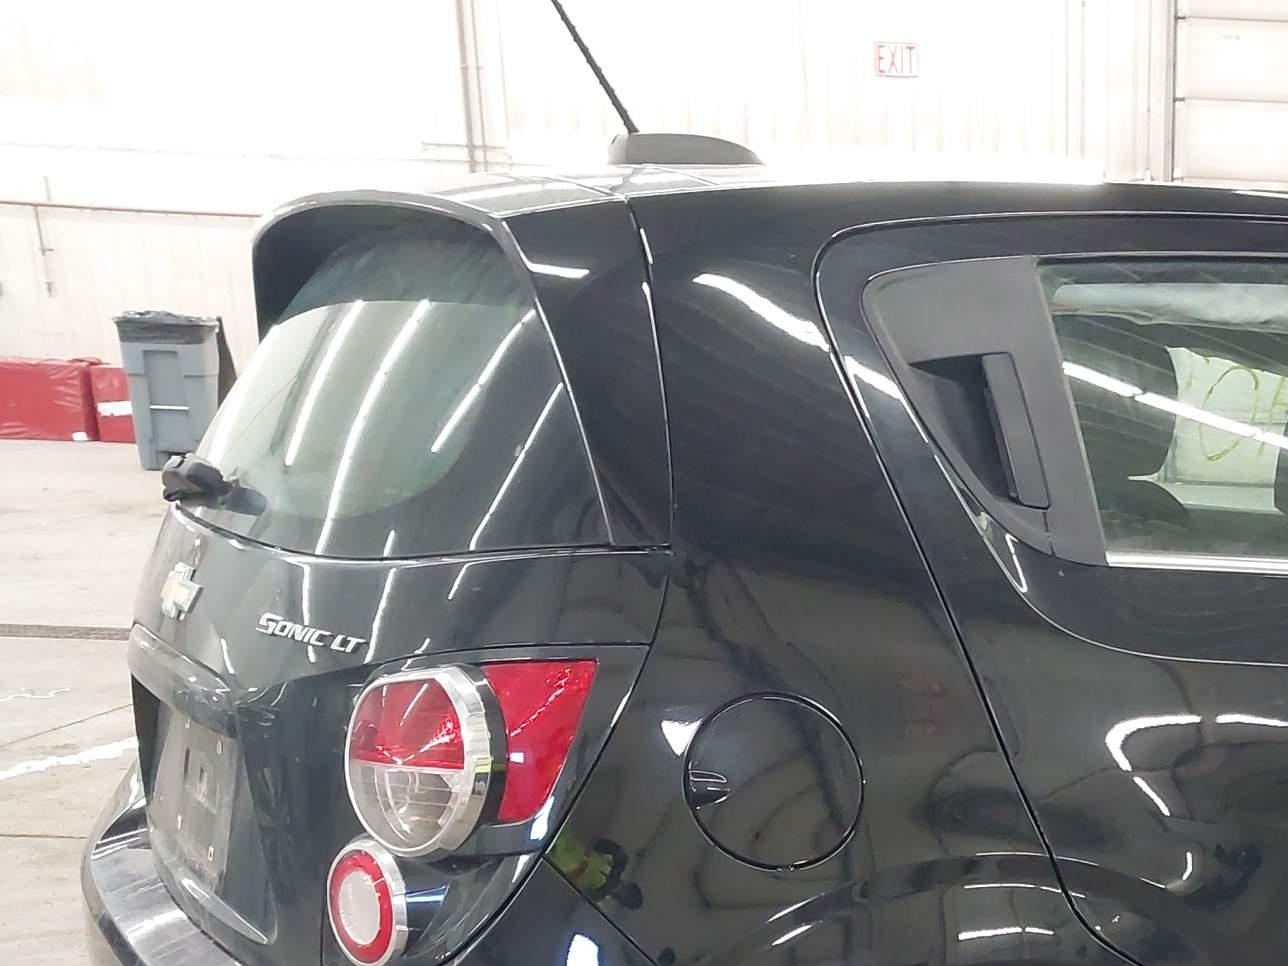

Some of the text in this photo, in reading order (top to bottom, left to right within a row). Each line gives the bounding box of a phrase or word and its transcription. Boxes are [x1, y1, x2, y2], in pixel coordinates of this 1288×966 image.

[876, 44, 915, 74] EXIT
[255, 612, 368, 653] SONIC LT
